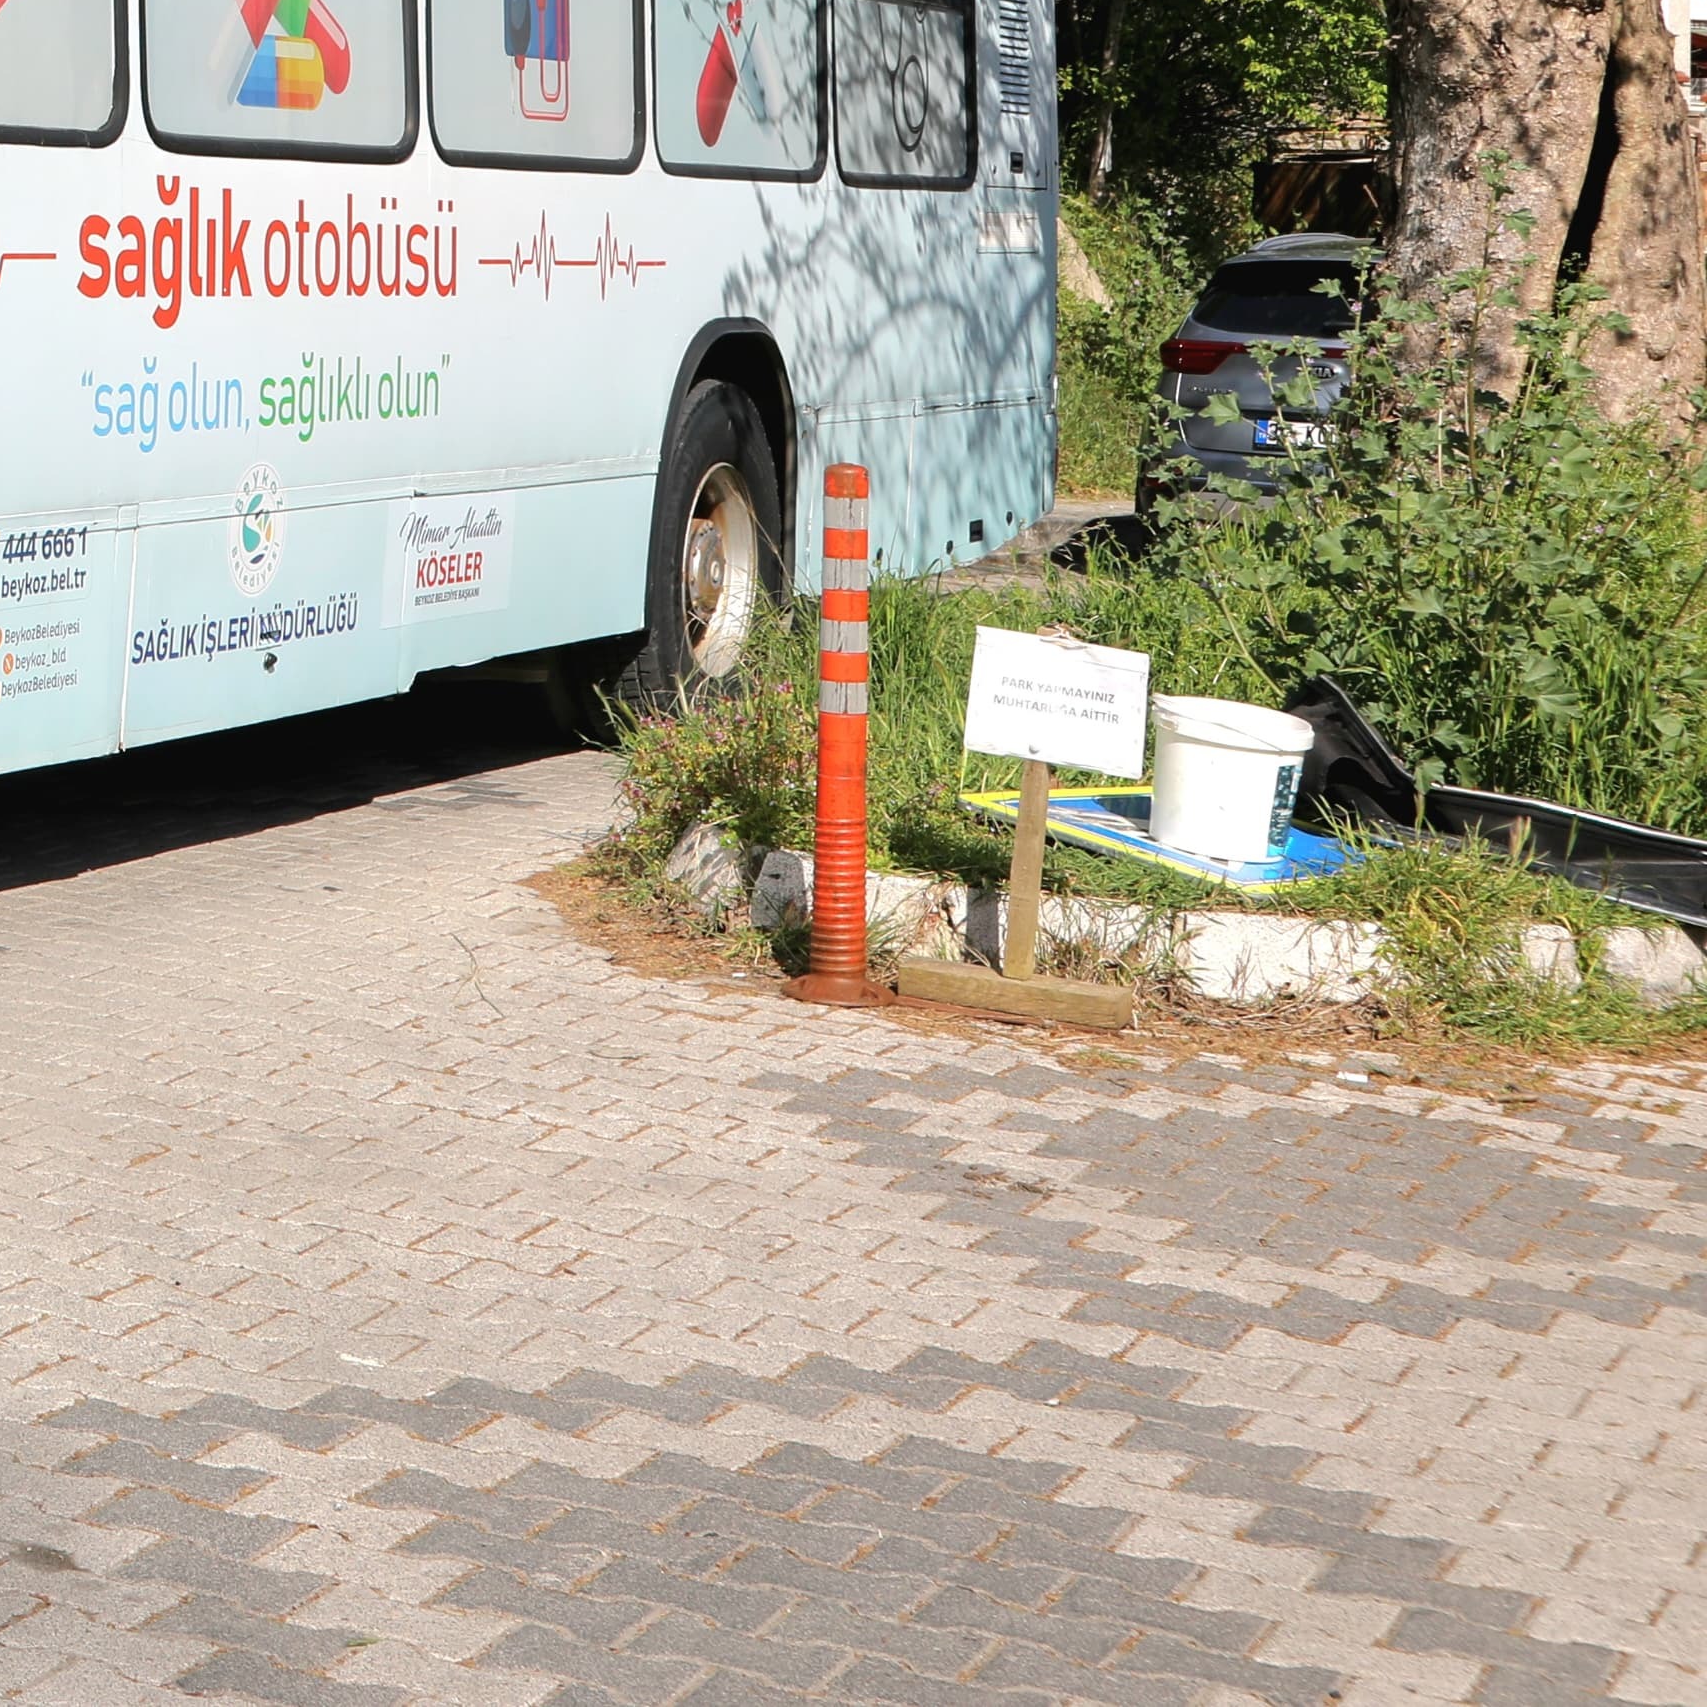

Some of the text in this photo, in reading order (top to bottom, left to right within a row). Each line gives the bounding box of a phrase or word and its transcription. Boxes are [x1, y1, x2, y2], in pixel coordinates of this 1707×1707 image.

[76, 174, 457, 330] sağlık otobüsü
[168, 361, 250, 435] olun,
[258, 351, 371, 442] sağlıklı
[235, 467, 284, 514] Beykoz
[2, 531, 37, 564] 444
[399, 505, 503, 554] Mimar Alaattin
[1, 567, 87, 602] beykoz.bel.tr
[415, 550, 484, 589] KÖSELER
[4, 618, 81, 646] BeykozBelediyesi
[131, 592, 359, 665] SAĞLIK İŞLERİ MÜDÜRLÜĞÜ
[14, 647, 67, 672] beykoz_bld
[1000, 676, 1034, 691] PARK
[1080, 707, 1120, 725] AİTTİR
